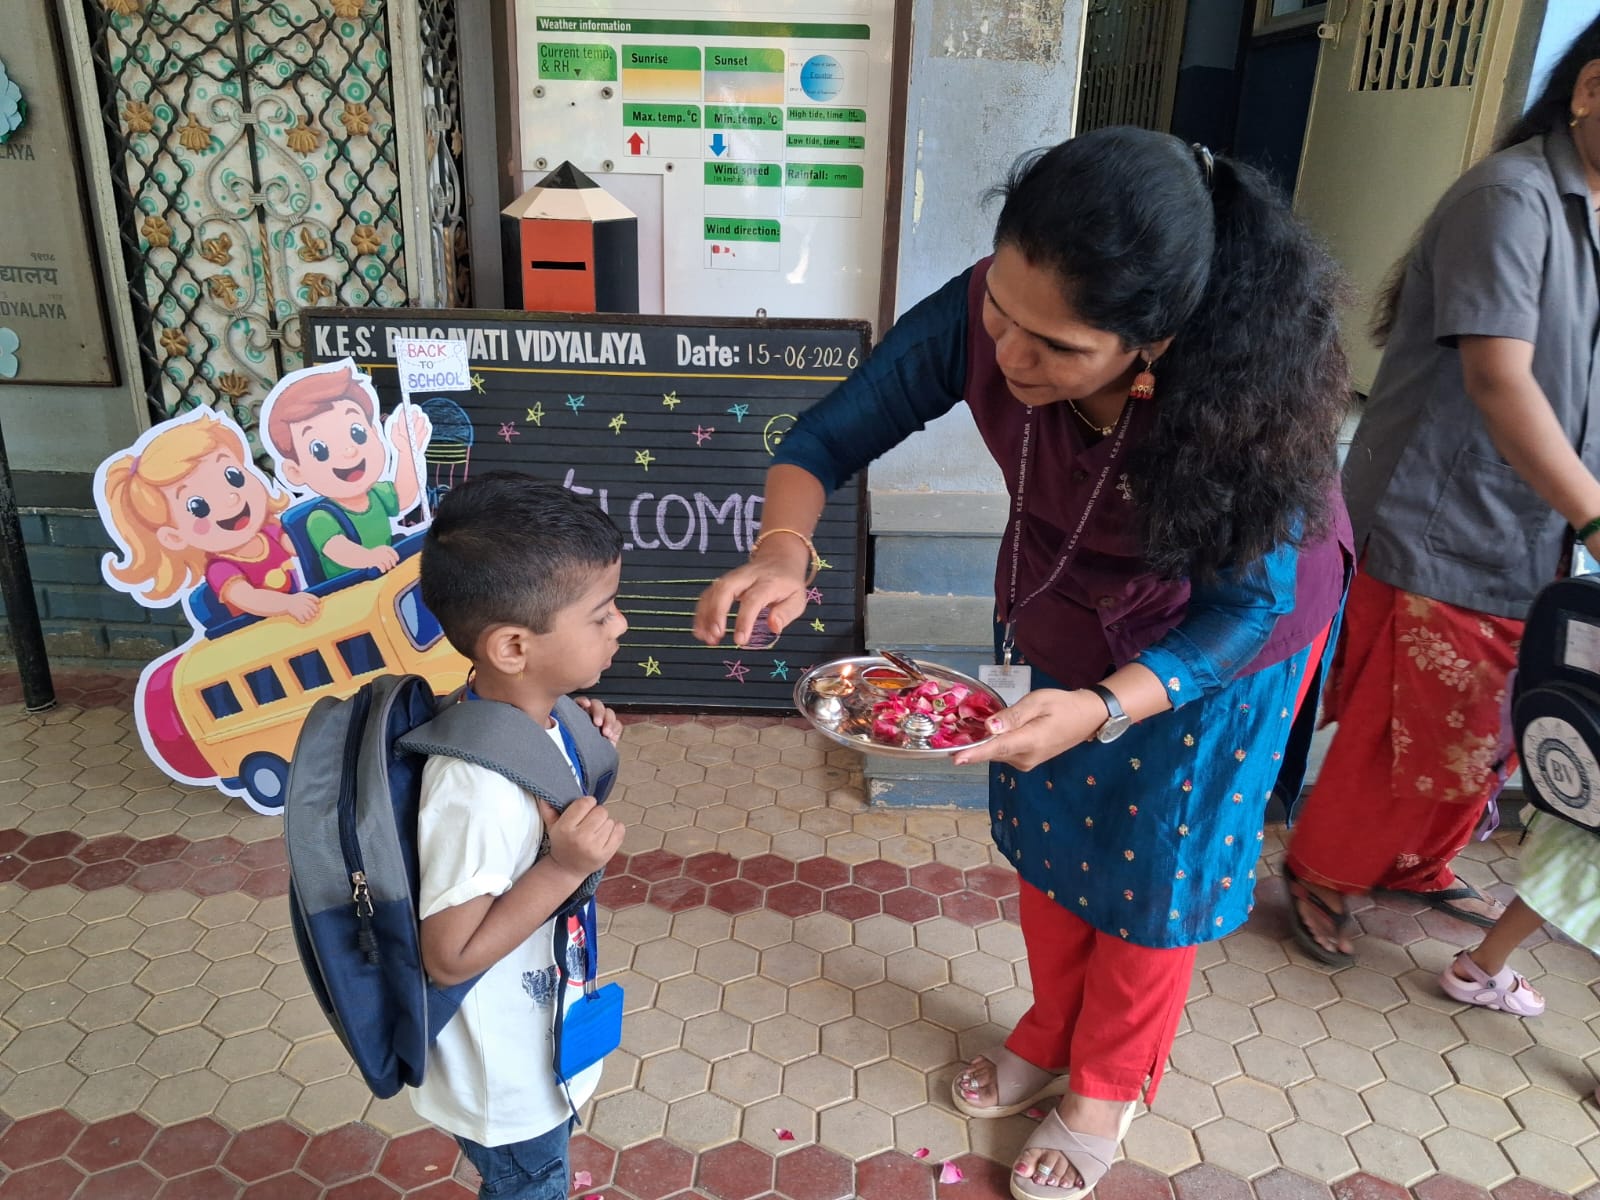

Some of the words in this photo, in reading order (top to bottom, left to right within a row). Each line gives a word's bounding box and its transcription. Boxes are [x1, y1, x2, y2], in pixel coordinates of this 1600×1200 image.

[539, 18, 577, 31] Weather
[579, 19, 632, 32] information
[540, 45, 580, 59] Current
[583, 47, 613, 62] temp.
[631, 53, 668, 64] Sunrise
[714, 55, 748, 66] Sunset
[541, 60, 550, 72] &
[554, 60, 570, 73] RH
[632, 111, 656, 122] Max.
[658, 112, 686, 125] temp.
[714, 113, 736, 124] Min.
[738, 114, 766, 127] temp.
[789, 109, 807, 119] High
[827, 111, 843, 119] time
[788, 136, 803, 145] Low
[823, 138, 840, 146] time
[714, 164, 738, 175] Wind
[741, 165, 769, 177] speed
[788, 169, 828, 180] Rainfall:
[706, 224, 731, 235] Wind
[734, 225, 780, 236] direction:
[407, 344, 447, 358] BACK
[515, 329, 647, 366] VIDYALAYA
[676, 334, 740, 367] Date:
[748, 343, 859, 369] 15-06-2026
[420, 361, 434, 369] TO
[408, 372, 465, 388] SCHOOL
[1022, 422, 1031, 457] VIDYALAYA
[1018, 458, 1027, 494] BHAGAVATI
